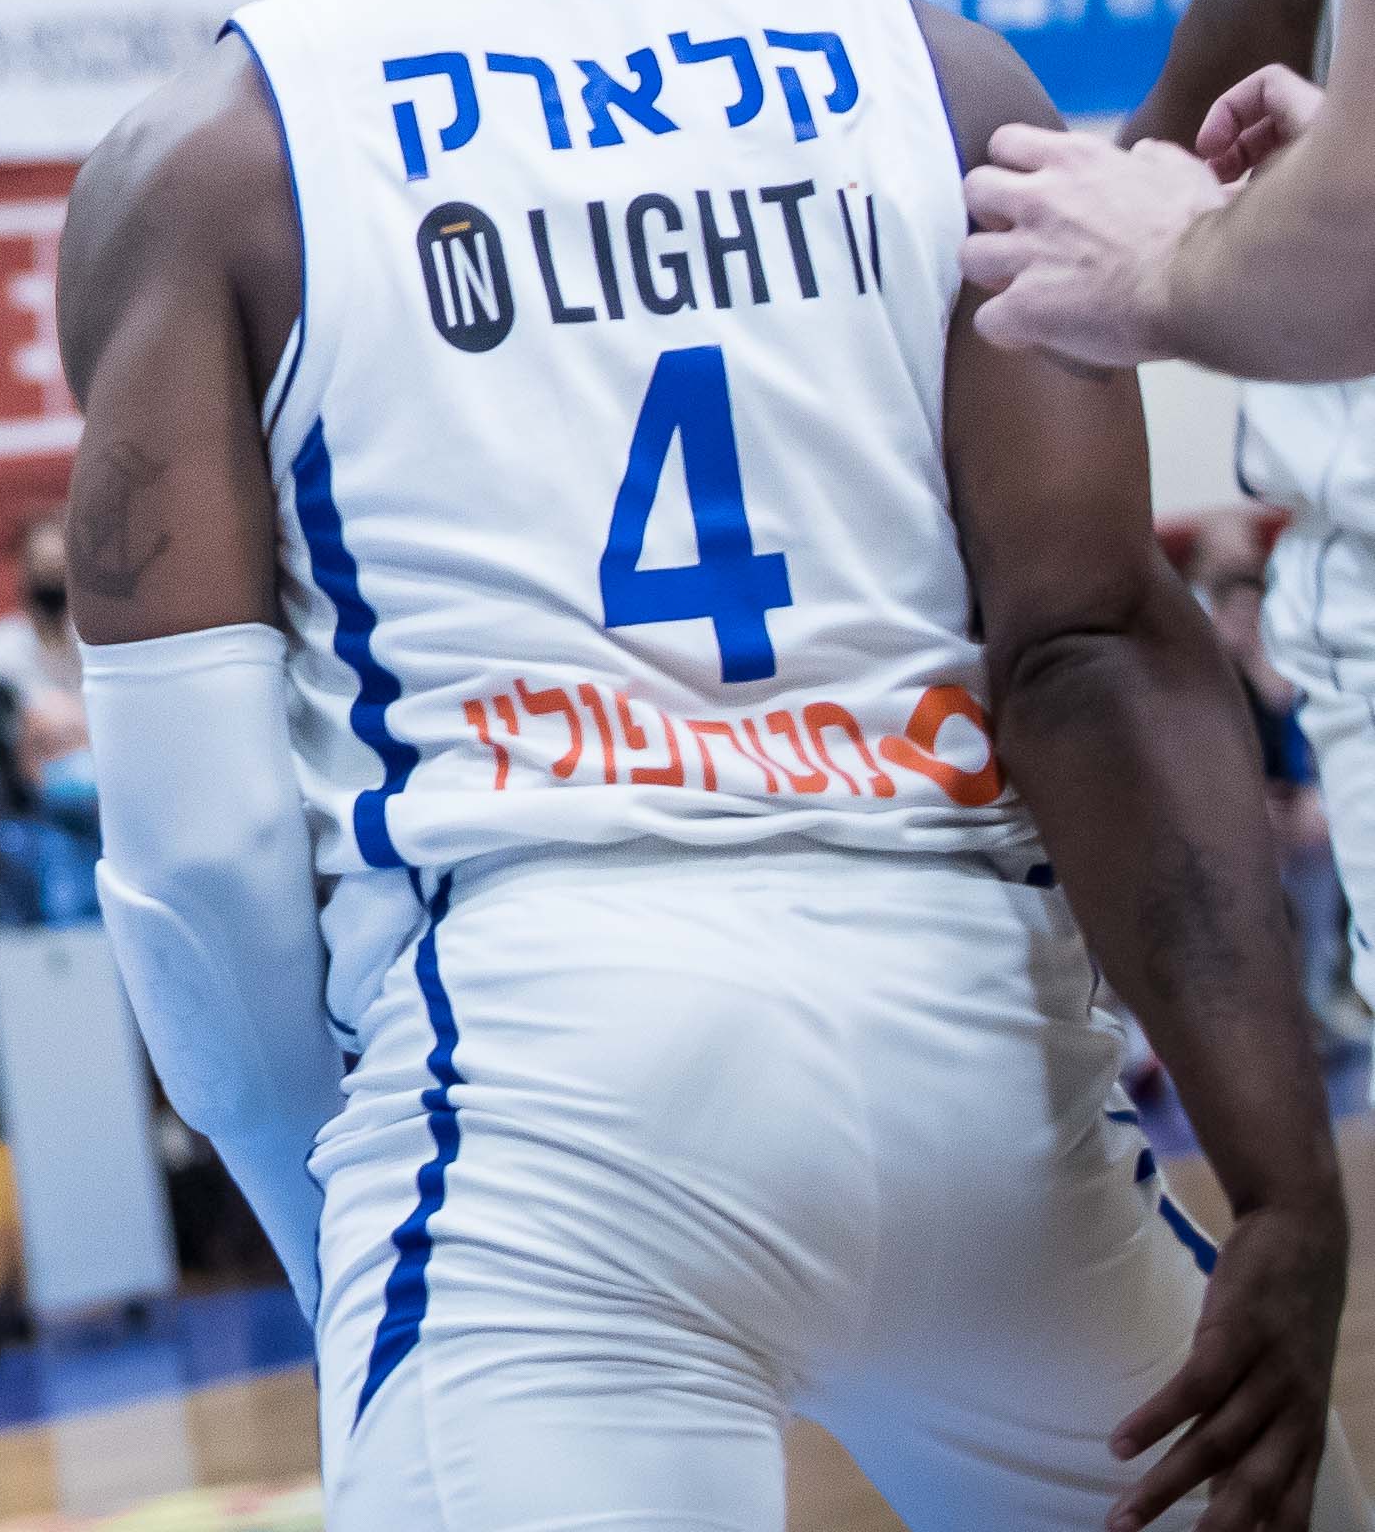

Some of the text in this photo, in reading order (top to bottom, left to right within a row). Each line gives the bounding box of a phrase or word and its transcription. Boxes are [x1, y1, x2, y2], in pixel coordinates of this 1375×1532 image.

[381, 27, 861, 182] קלארק
[528, 180, 820, 325] LIGHT
[599, 343, 795, 685] 4
